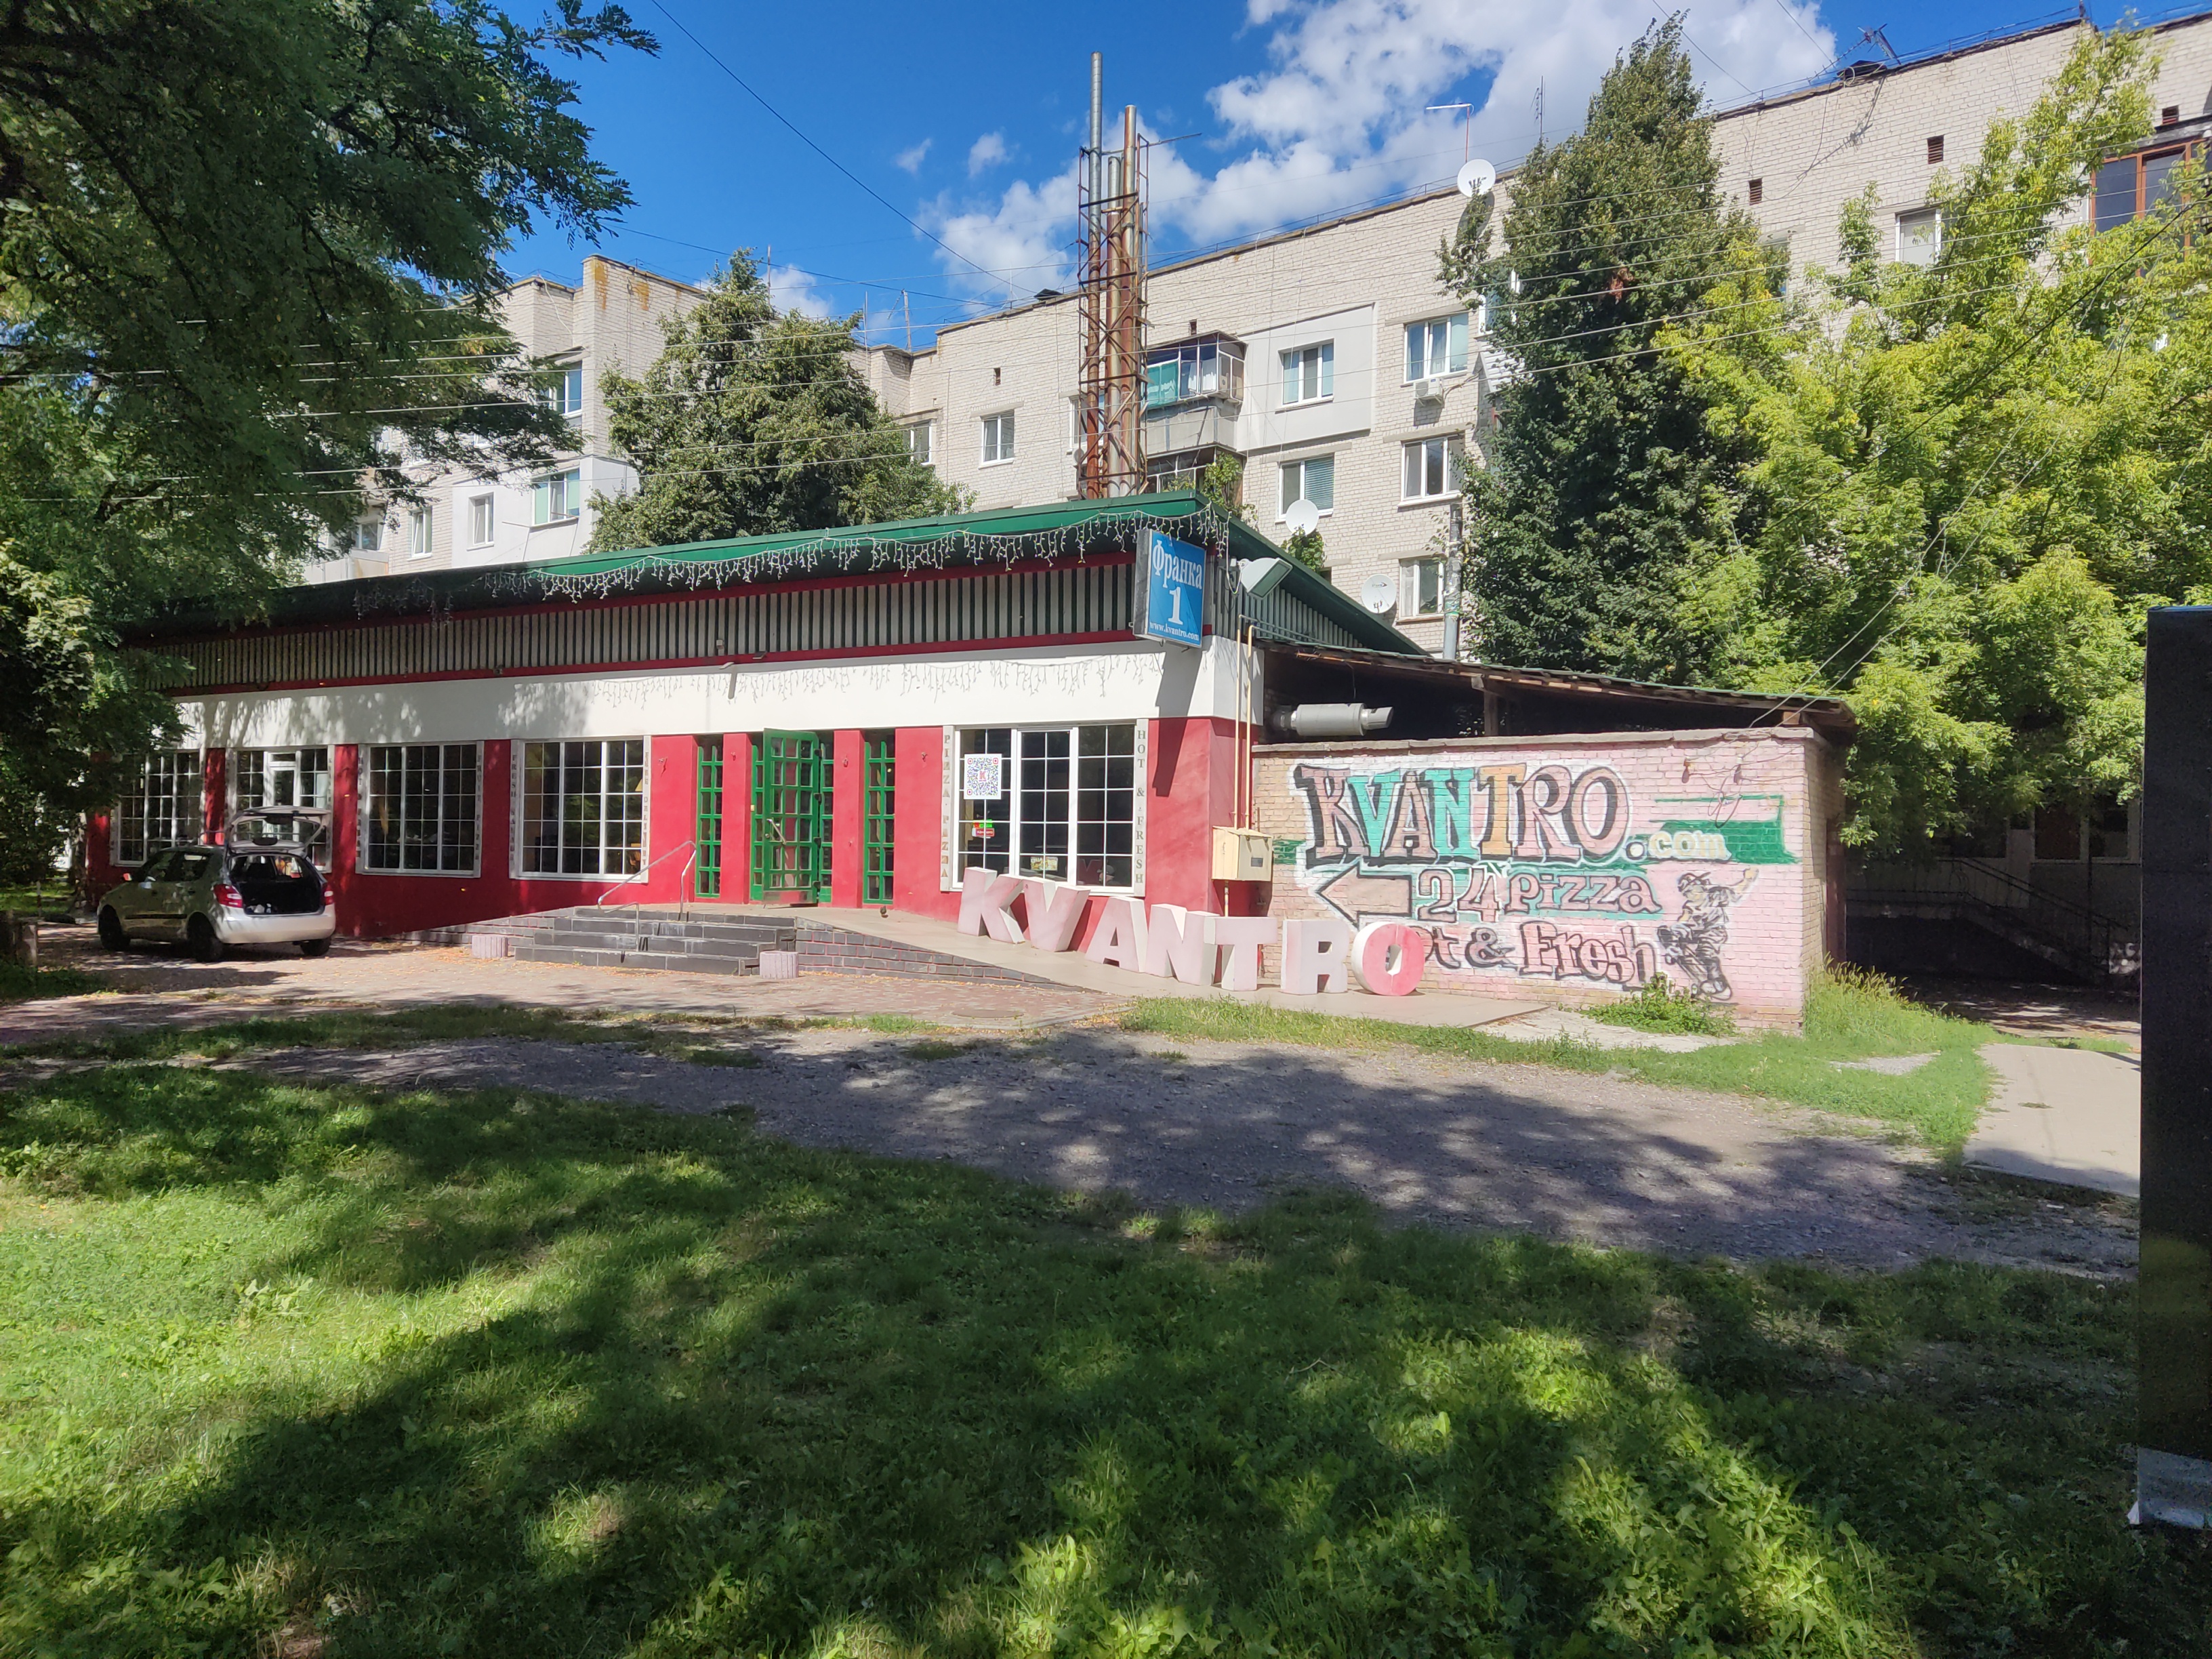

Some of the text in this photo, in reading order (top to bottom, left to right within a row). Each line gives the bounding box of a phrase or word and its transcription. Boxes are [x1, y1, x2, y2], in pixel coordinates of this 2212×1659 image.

[1153, 539, 1202, 590] Франка
[1149, 621, 1200, 641] www.kvantro.com
[1168, 587, 1183, 625] 1
[942, 735, 951, 798] PIZZA
[1135, 730, 1146, 884] HOT & FRESH
[1418, 867, 1500, 923] 24
[957, 867, 1424, 997] KVANTRO
[1465, 927, 1513, 968] &
[1519, 920, 1657, 987] Fresh
